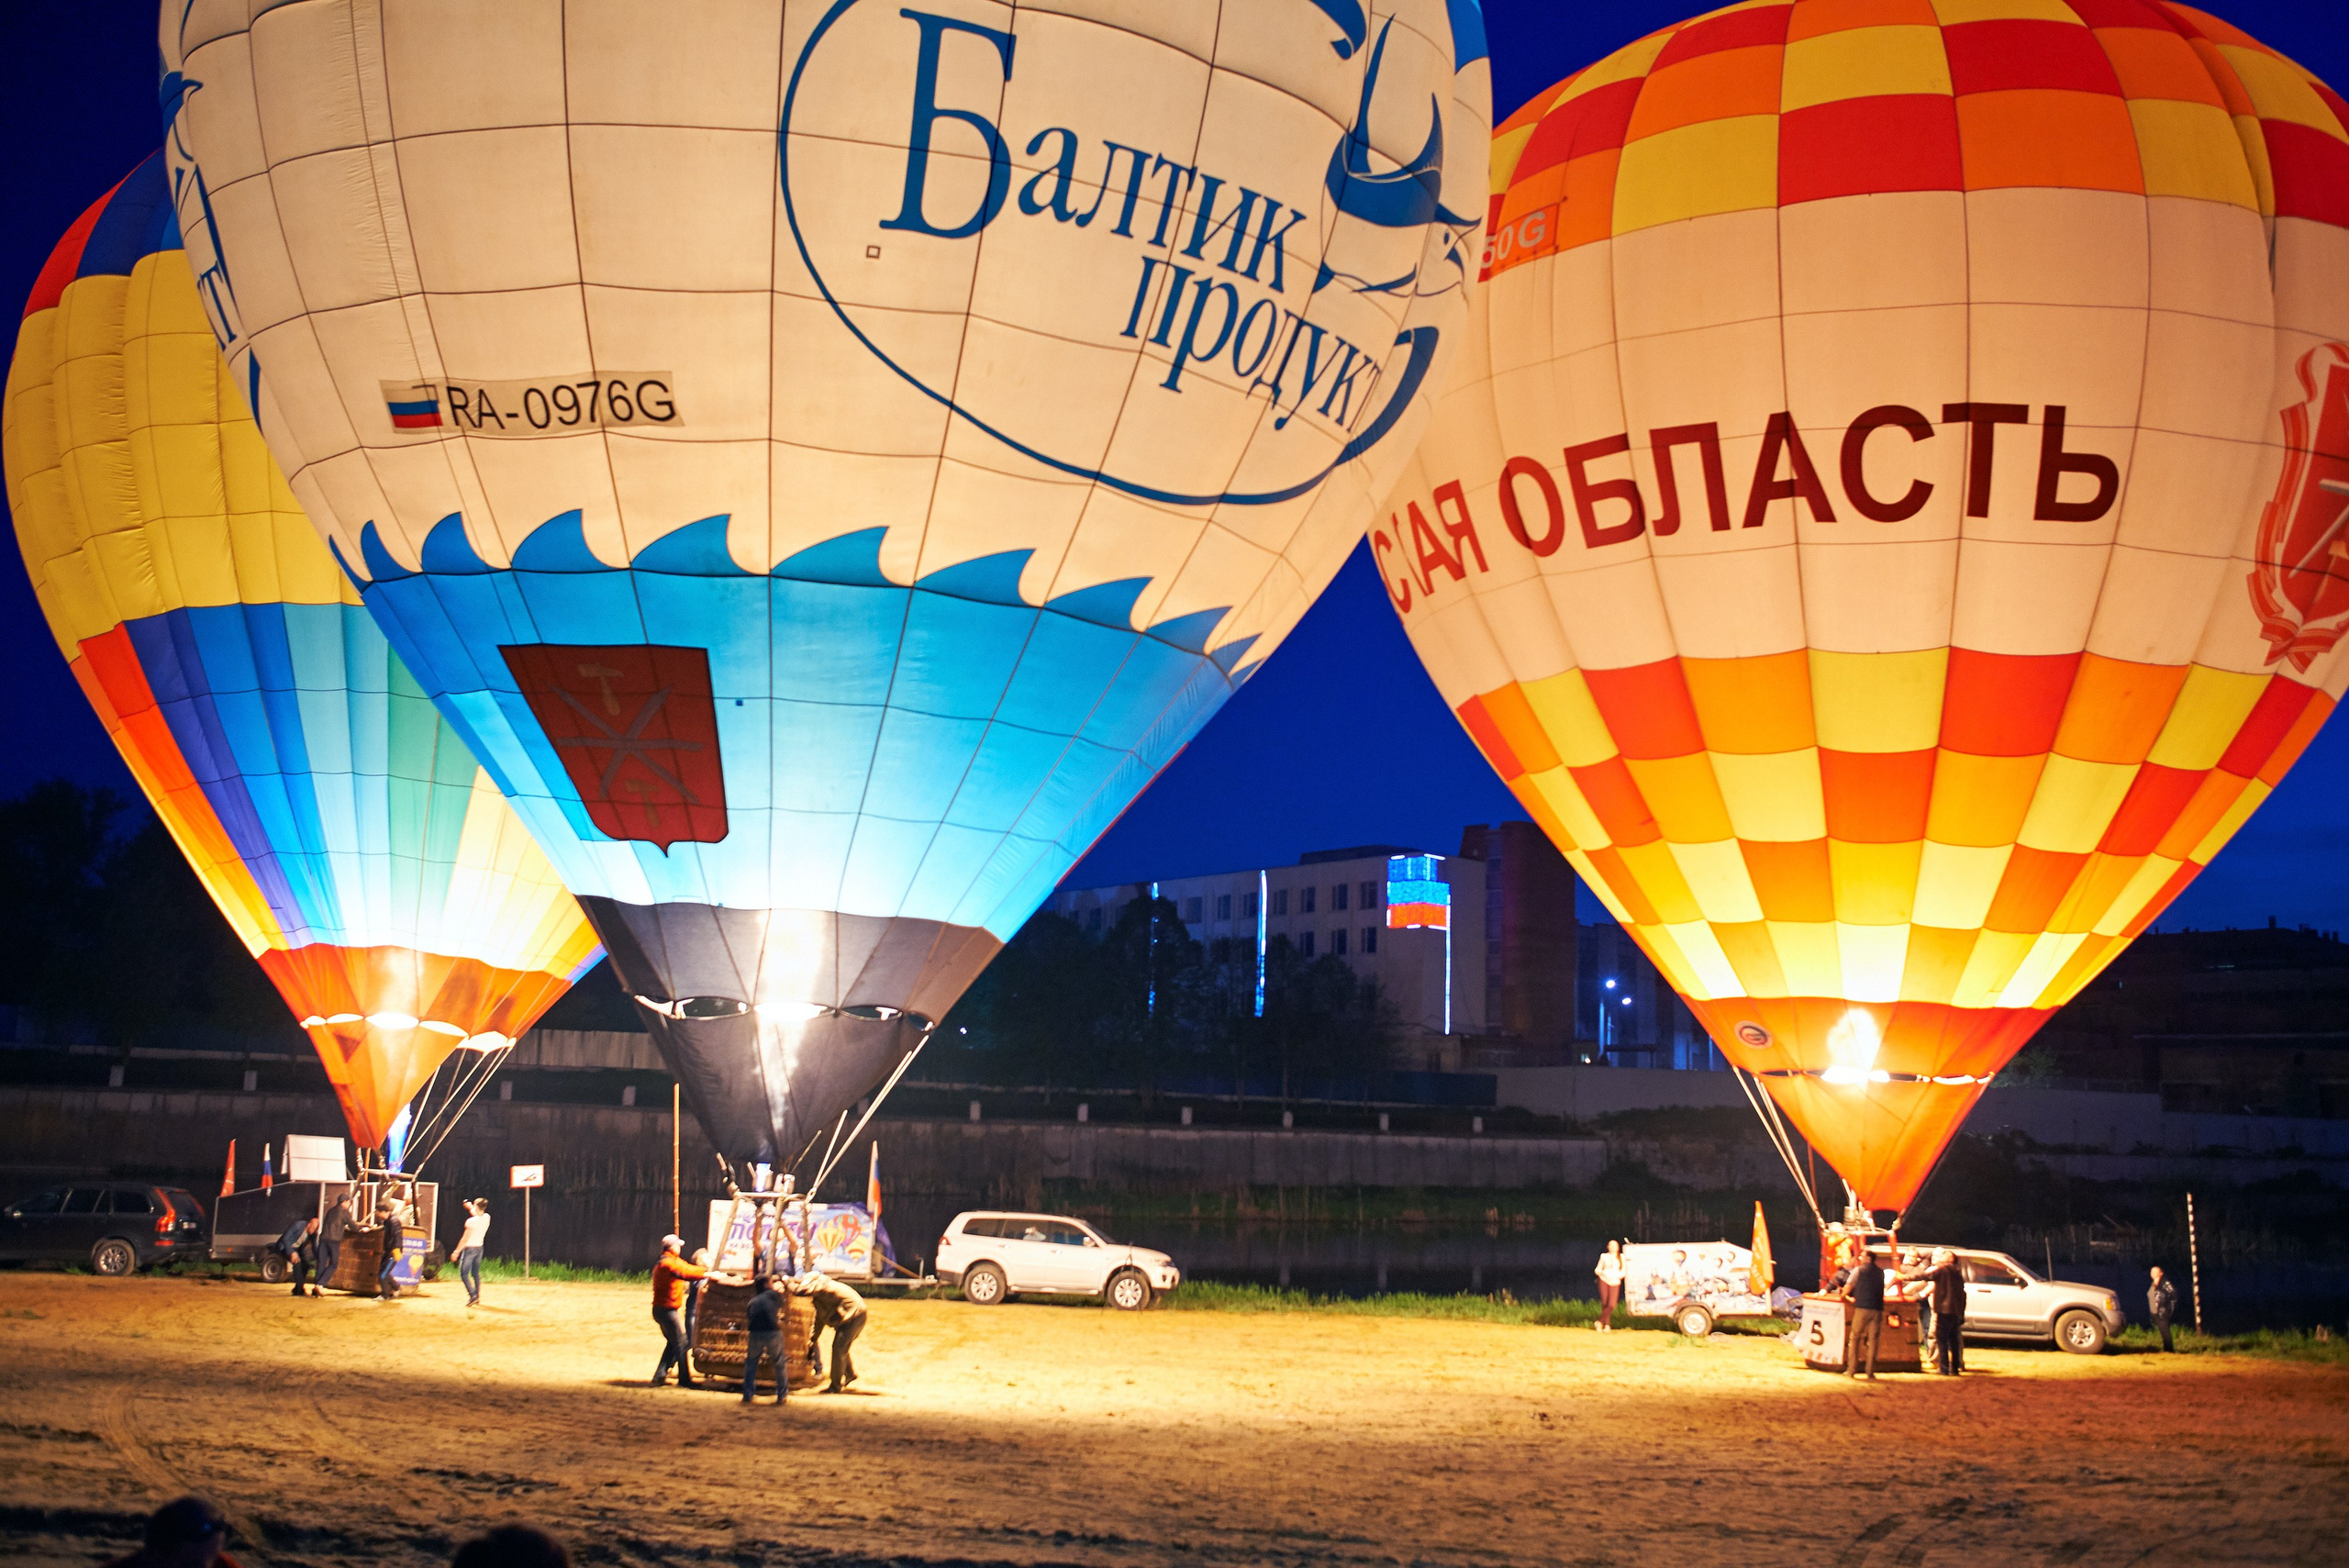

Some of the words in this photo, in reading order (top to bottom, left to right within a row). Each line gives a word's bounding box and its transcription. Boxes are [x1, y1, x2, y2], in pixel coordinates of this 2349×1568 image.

[878, 7, 1307, 294] Балтик
[446, 379, 677, 430] RA-0976G
[1497, 403, 2121, 558] ОБЛАСТЬ
[1810, 1319, 1825, 1346] 5
